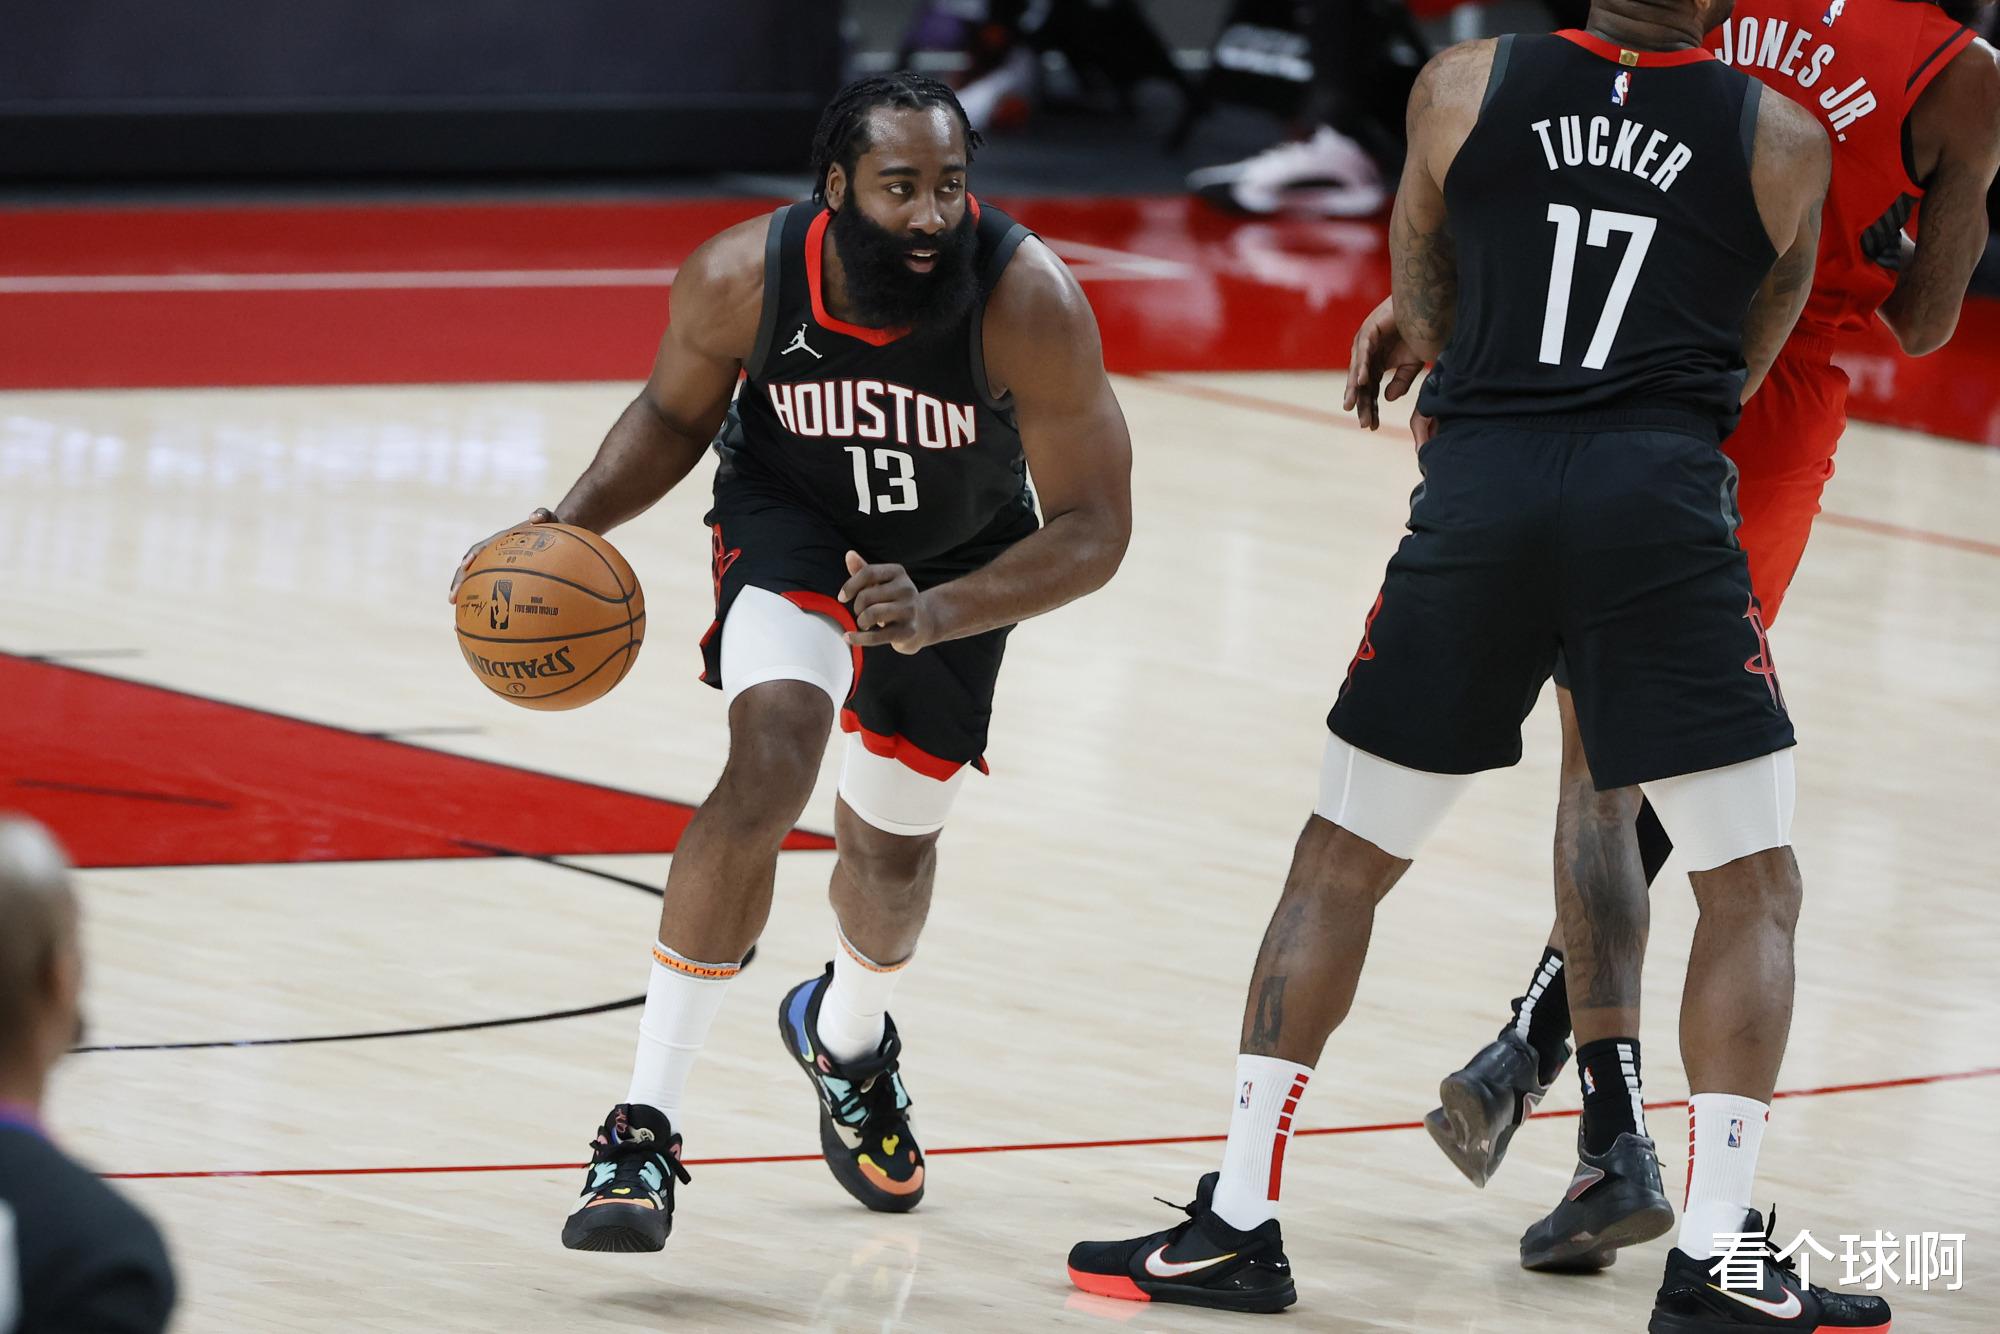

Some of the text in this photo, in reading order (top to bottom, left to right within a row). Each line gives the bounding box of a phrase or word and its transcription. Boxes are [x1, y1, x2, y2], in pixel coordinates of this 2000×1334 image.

[1714, 16, 1877, 142] JONES JR.
[1531, 115, 1693, 193] TUCKER
[1538, 203, 1658, 370] 17
[767, 380, 977, 449] HOUSTON
[843, 446, 919, 515] 13
